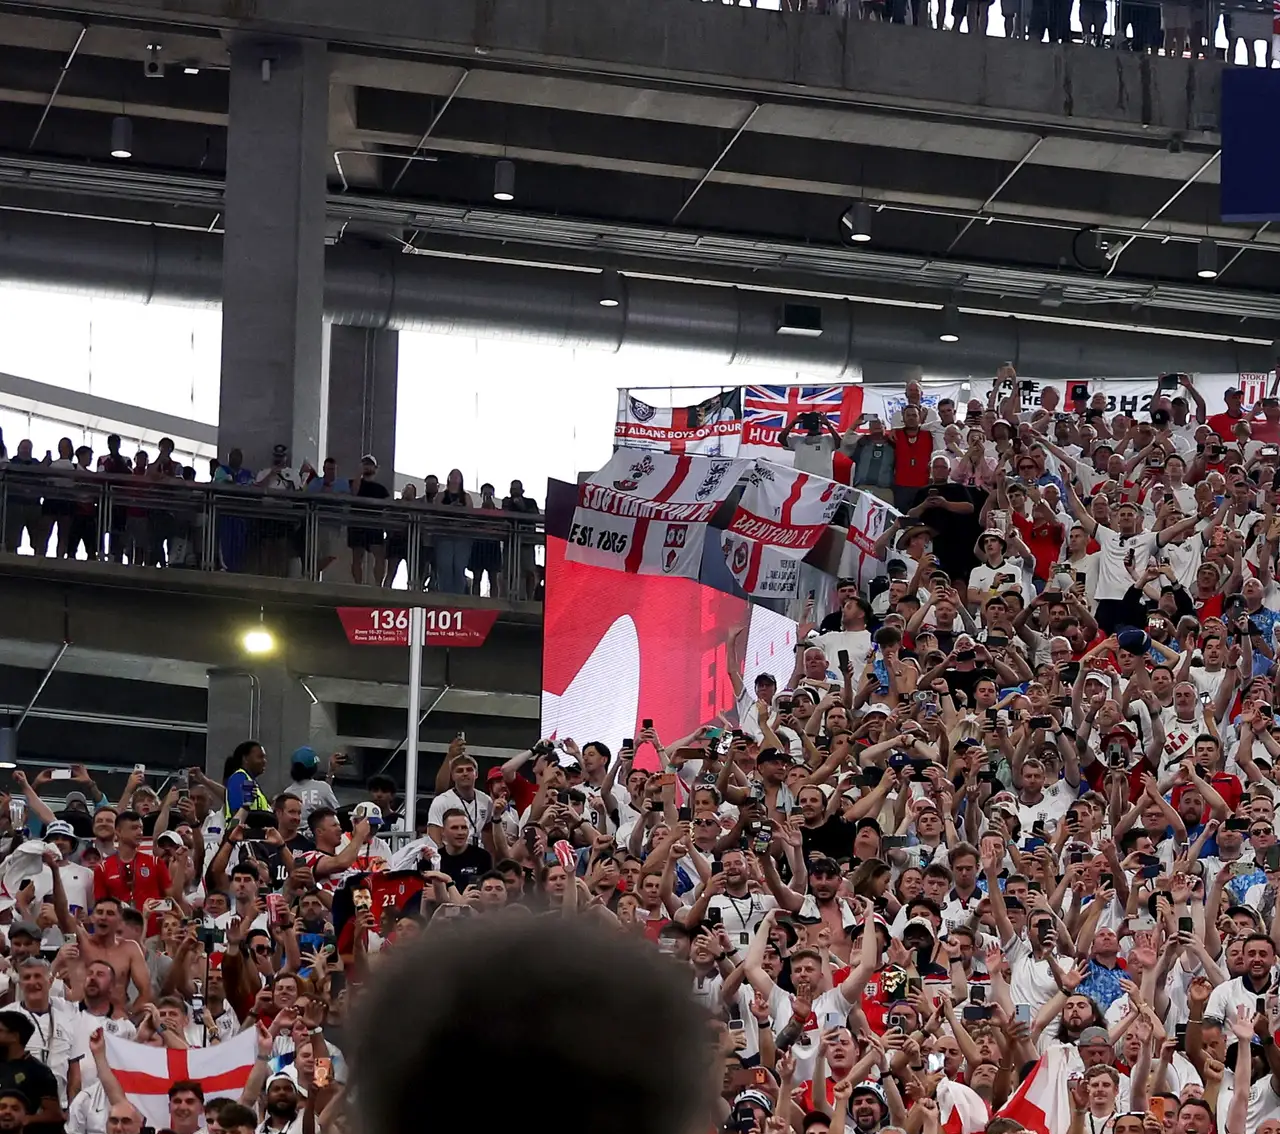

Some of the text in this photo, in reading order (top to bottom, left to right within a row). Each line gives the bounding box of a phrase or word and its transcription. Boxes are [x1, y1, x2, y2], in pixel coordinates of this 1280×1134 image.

[1240, 372, 1267, 381] STOKE
[629, 426, 667, 439] ALBANS
[667, 429, 694, 440] BOYS
[712, 422, 742, 436] TOUR
[583, 483, 693, 520] SOUTHAMPTON
[568, 523, 594, 548] EST.
[733, 514, 814, 546] BRENTFORD FC
[370, 610, 408, 629] 136
[427, 610, 463, 630] 101
[276, 865, 289, 880] 10
[381, 894, 396, 908] 23
